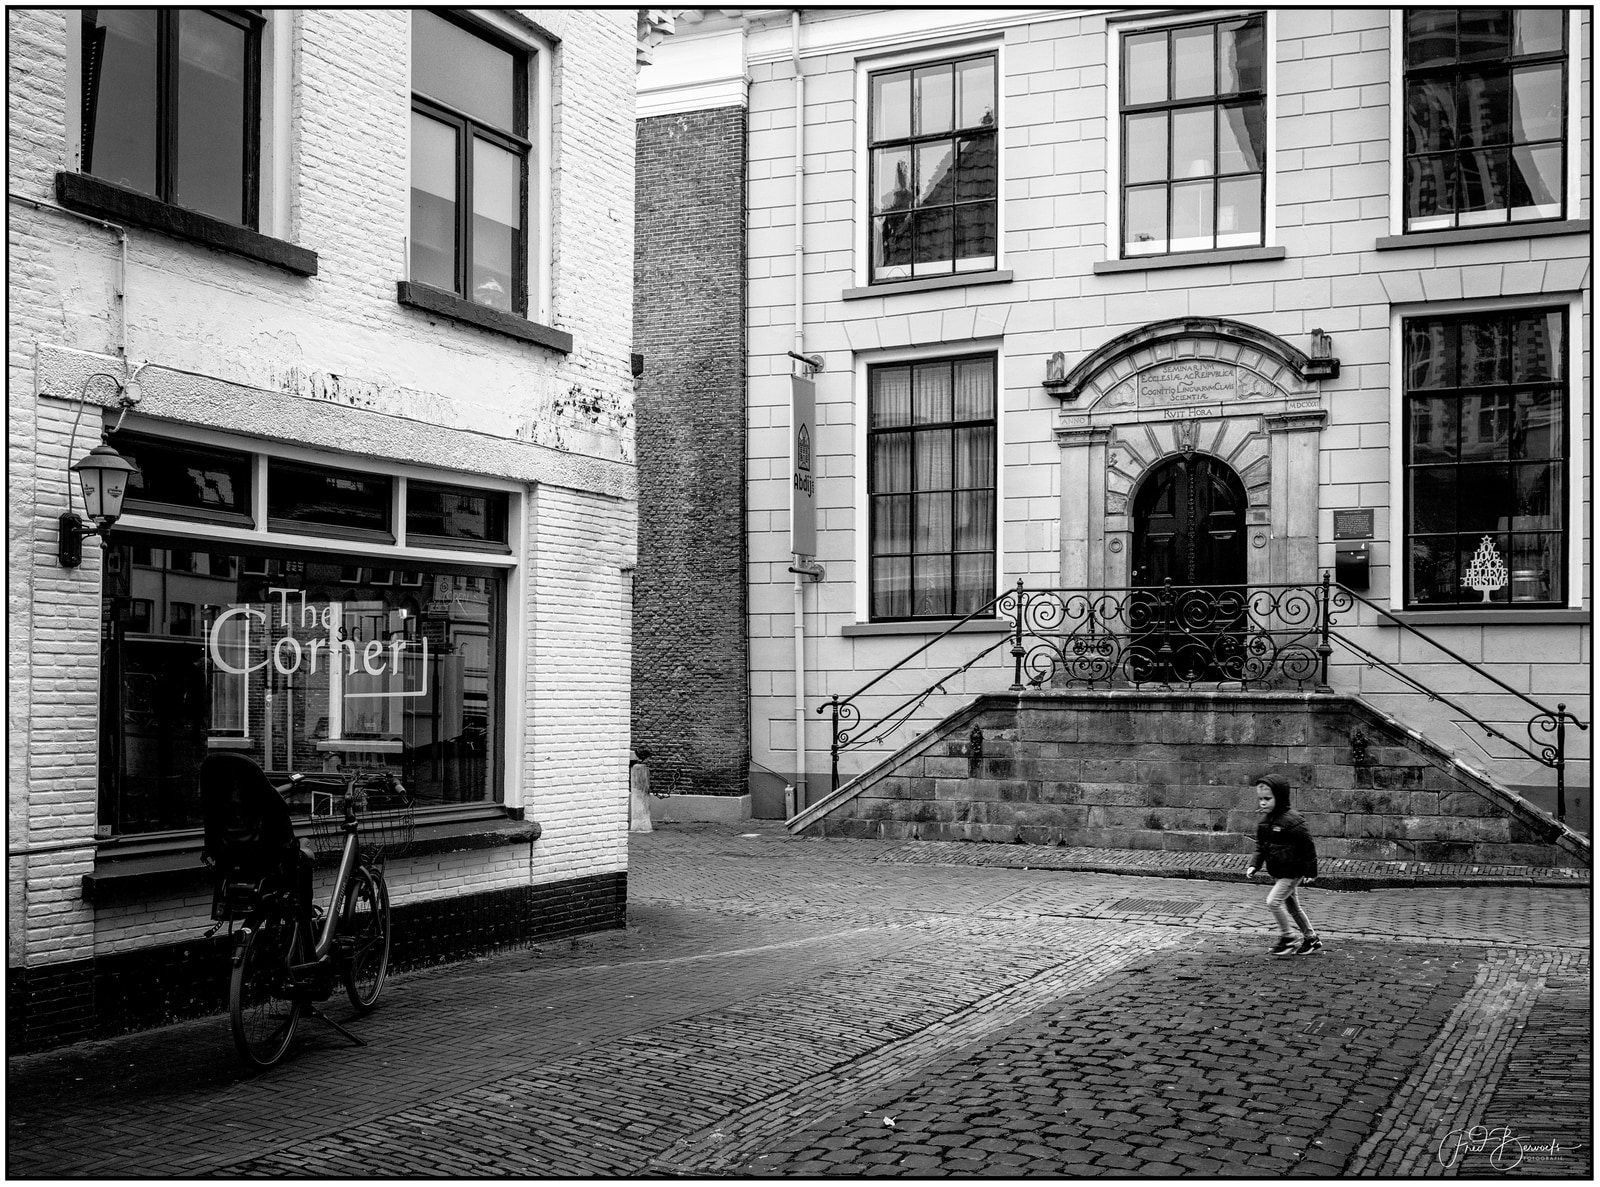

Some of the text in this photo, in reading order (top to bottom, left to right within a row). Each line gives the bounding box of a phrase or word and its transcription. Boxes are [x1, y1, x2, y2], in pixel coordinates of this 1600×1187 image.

[1163, 363, 1215, 373] SEMINARIVM
[1164, 407, 1213, 418] RVIT HORA
[1060, 417, 1086, 425] ANNO
[794, 472, 812, 498] Abdij
[1477, 542, 1497, 553] JOY
[1473, 551, 1500, 561] LOVE
[1470, 559, 1504, 570] PEACE
[1465, 567, 1508, 578] BELIEVE
[268, 587, 337, 630] The
[209, 607, 407, 676] Corner
